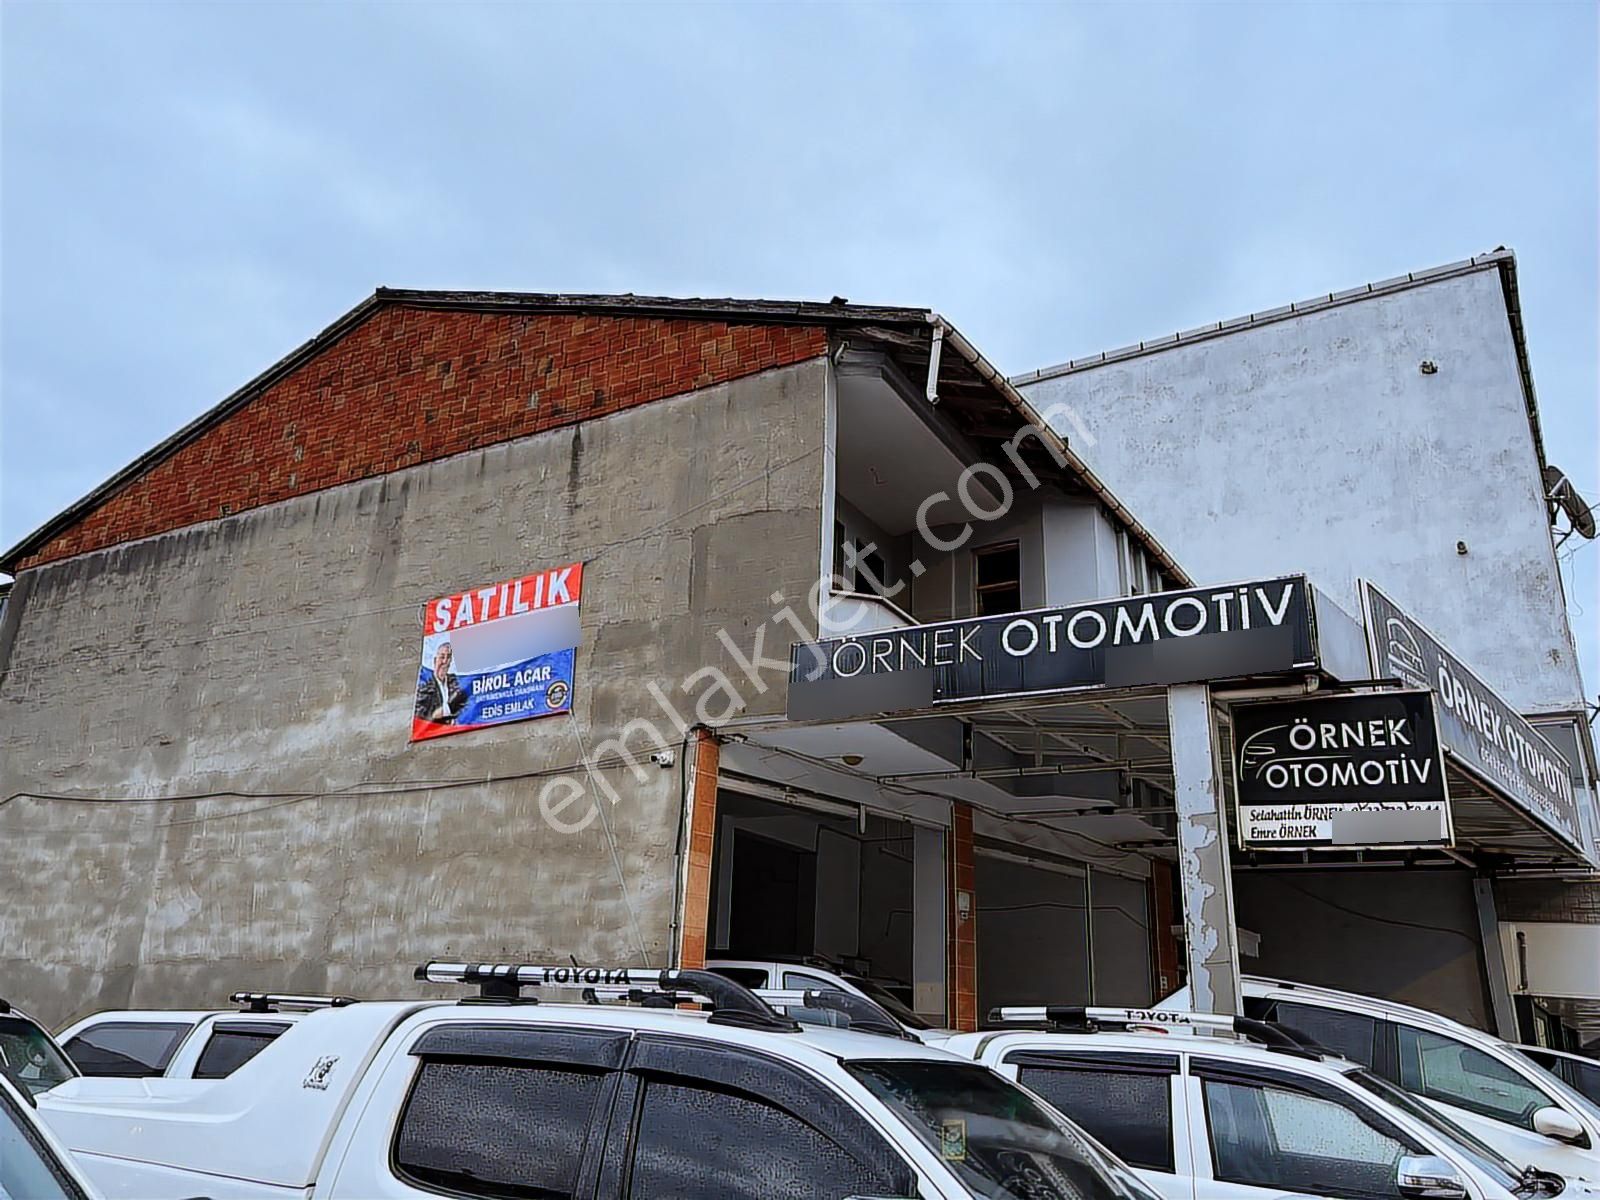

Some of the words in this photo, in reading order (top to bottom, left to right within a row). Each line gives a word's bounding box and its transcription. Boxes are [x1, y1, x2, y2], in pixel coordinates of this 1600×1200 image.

[433, 567, 572, 633] SATILIK
[831, 624, 984, 678] ÖRNEK
[1001, 583, 1295, 657] OTOMOTİV
[472, 673, 511, 695] BİROL
[513, 665, 551, 687] ACAR
[482, 703, 503, 719] EDİS
[504, 698, 535, 715] EMLAK
[1289, 717, 1411, 750] ÖRNEK
[1437, 653, 1506, 751] ÖRNEK
[1505, 720, 1573, 807] OTOMOTİV
[1265, 753, 1432, 789] OTOMOTİV
[1249, 806, 1302, 822] Selahattin
[1303, 804, 1343, 821] ÖRNE
[1250, 827, 1277, 839] Emre
[1279, 824, 1317, 838] ÖRNEK
[541, 967, 631, 985] TOYOTA
